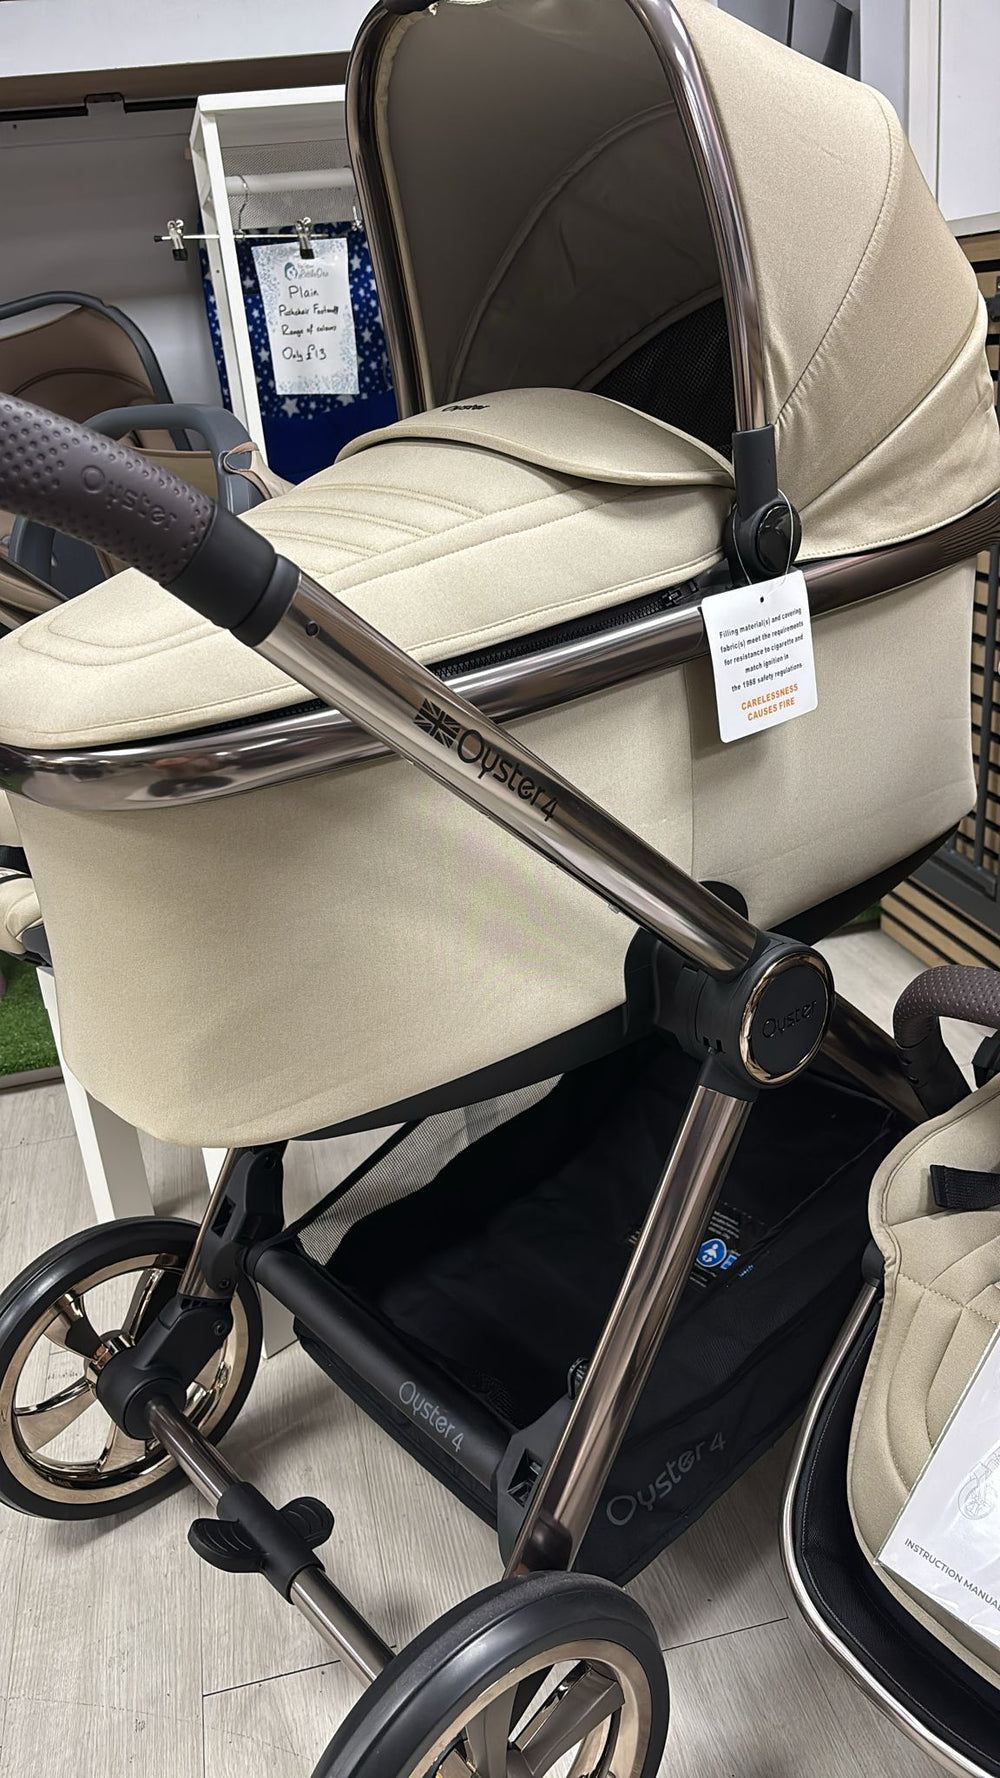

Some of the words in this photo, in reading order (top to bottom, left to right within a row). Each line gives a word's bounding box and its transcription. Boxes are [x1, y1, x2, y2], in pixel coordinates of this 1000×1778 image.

[288, 286, 319, 299] Plain
[281, 324, 303, 337] Range
[307, 325, 313, 334] of
[282, 347, 303, 362] Only
[306, 344, 327, 360] £13
[81, 464, 178, 531] Oyster
[719, 629, 739, 638] Filling
[740, 617, 770, 633] material(s)
[771, 614, 781, 623] and
[782, 607, 802, 620] covering
[720, 639, 746, 653] fabric(s)
[747, 635, 761, 645] meet
[762, 632, 771, 640] the
[772, 621, 803, 640] requirements
[724, 658, 733, 666] for
[733, 648, 763, 664] resistance
[764, 645, 770, 654] to
[771, 638, 794, 652] cigarette
[795, 634, 803, 642] and
[745, 663, 762, 674] match
[763, 656, 783, 669] ignition
[732, 684, 741, 692] the
[743, 678, 756, 689] 1988
[758, 673, 774, 684] safety
[775, 663, 802, 677] regulations
[741, 683, 798, 711] CARELESSNESS
[747, 704, 778, 721] CAUSES
[779, 697, 795, 710] FIRE
[763, 1001, 817, 1038] Oyster
[399, 1381, 455, 1438] Oyster
[606, 1441, 705, 1526] Oyster
[904, 1538, 963, 1584] INSTRUCTION
